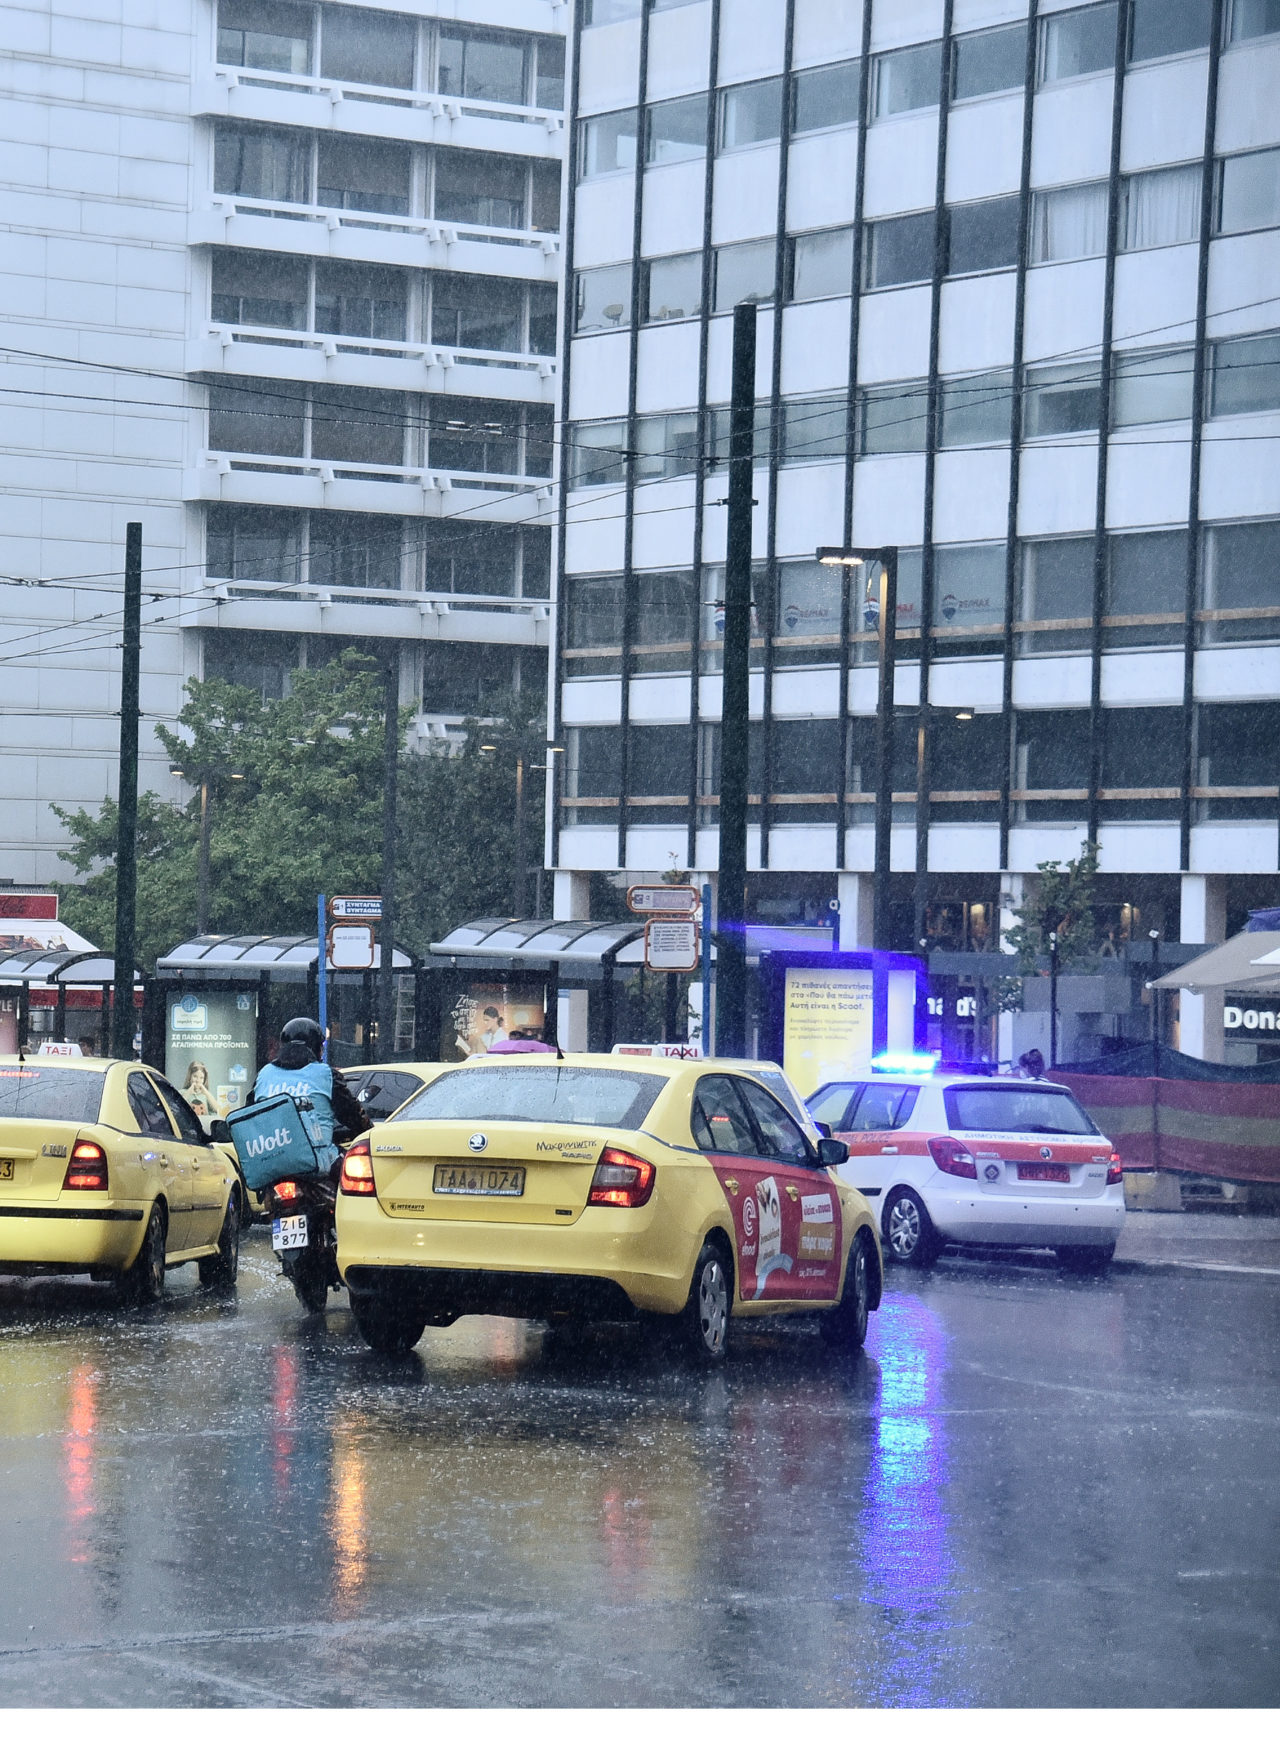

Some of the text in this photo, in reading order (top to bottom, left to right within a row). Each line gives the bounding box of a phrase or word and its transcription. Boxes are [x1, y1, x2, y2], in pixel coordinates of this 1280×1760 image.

[663, 1046, 698, 1058] TAXI
[268, 1081, 312, 1098] Wolt
[245, 1127, 293, 1158] Wolt
[282, 1233, 307, 1246] 877
